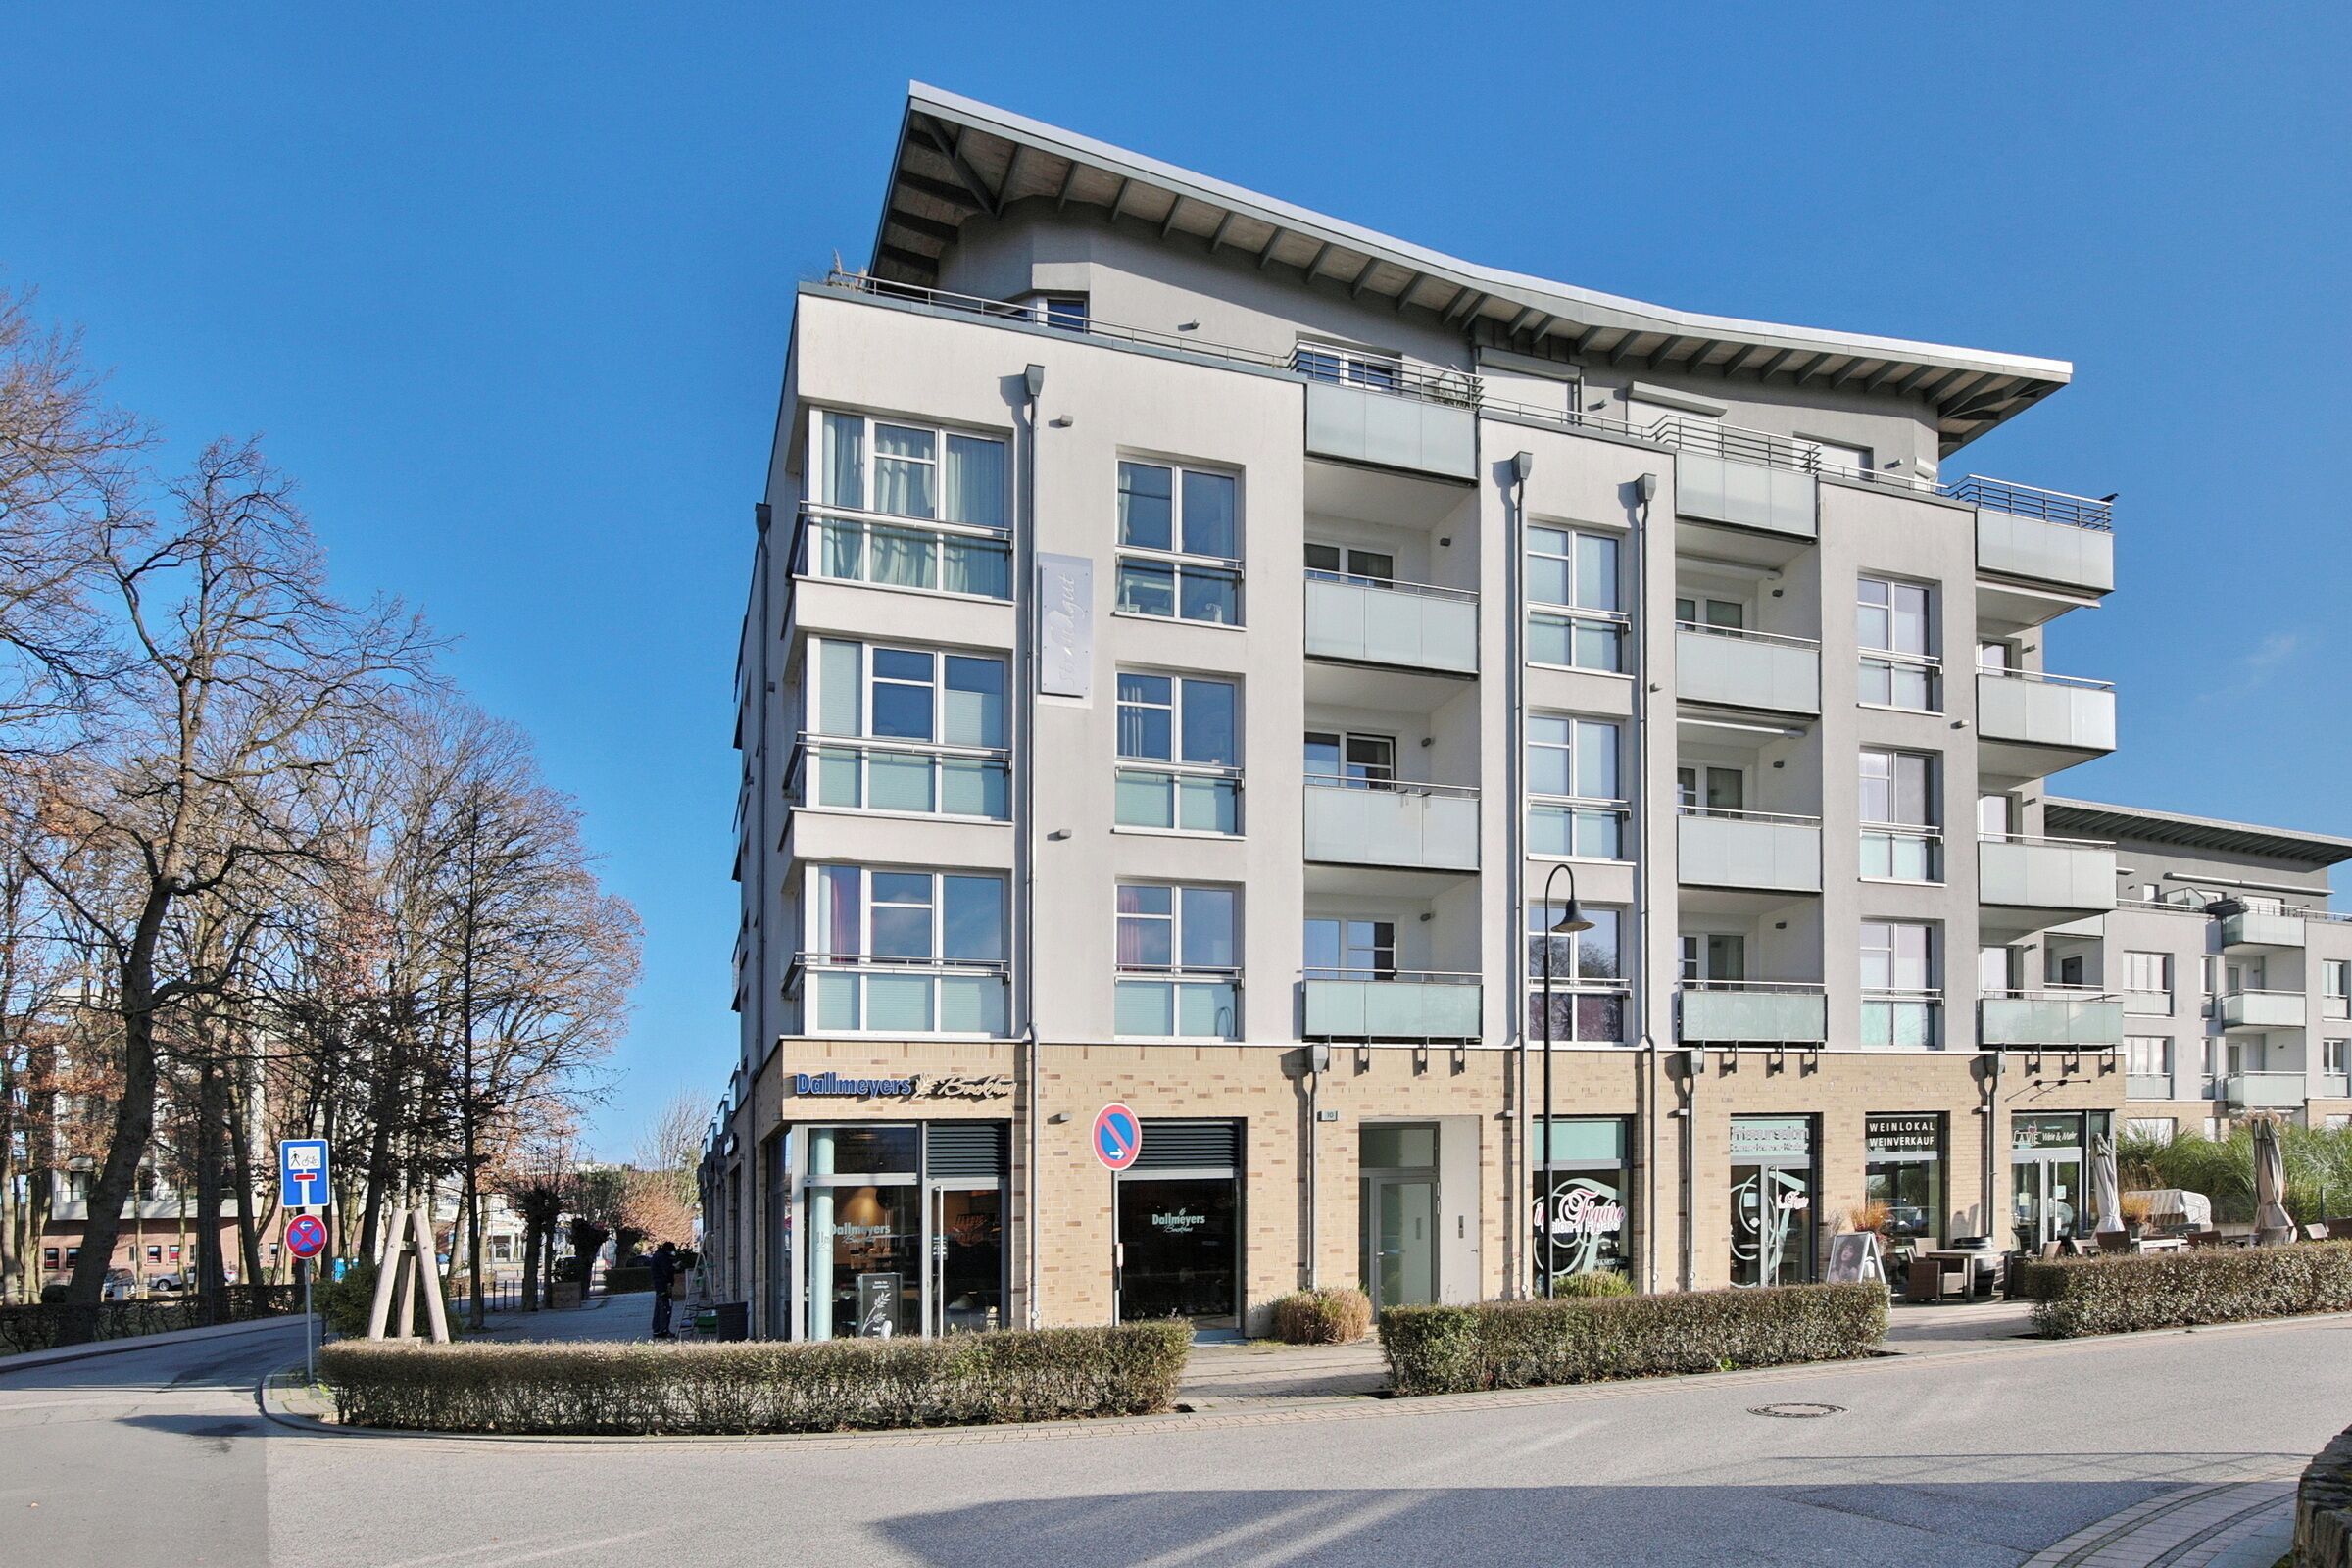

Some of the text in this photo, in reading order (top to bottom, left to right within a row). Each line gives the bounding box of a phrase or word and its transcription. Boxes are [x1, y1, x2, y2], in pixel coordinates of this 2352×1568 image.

[796, 1071, 911, 1098] Dallmeyers
[1869, 1121, 1935, 1132] WEINLOKAL
[1869, 1136, 1935, 1147] WEINVERKAUF
[1558, 1187, 1626, 1235] Figaro
[1152, 1212, 1206, 1227] Dallmeyers
